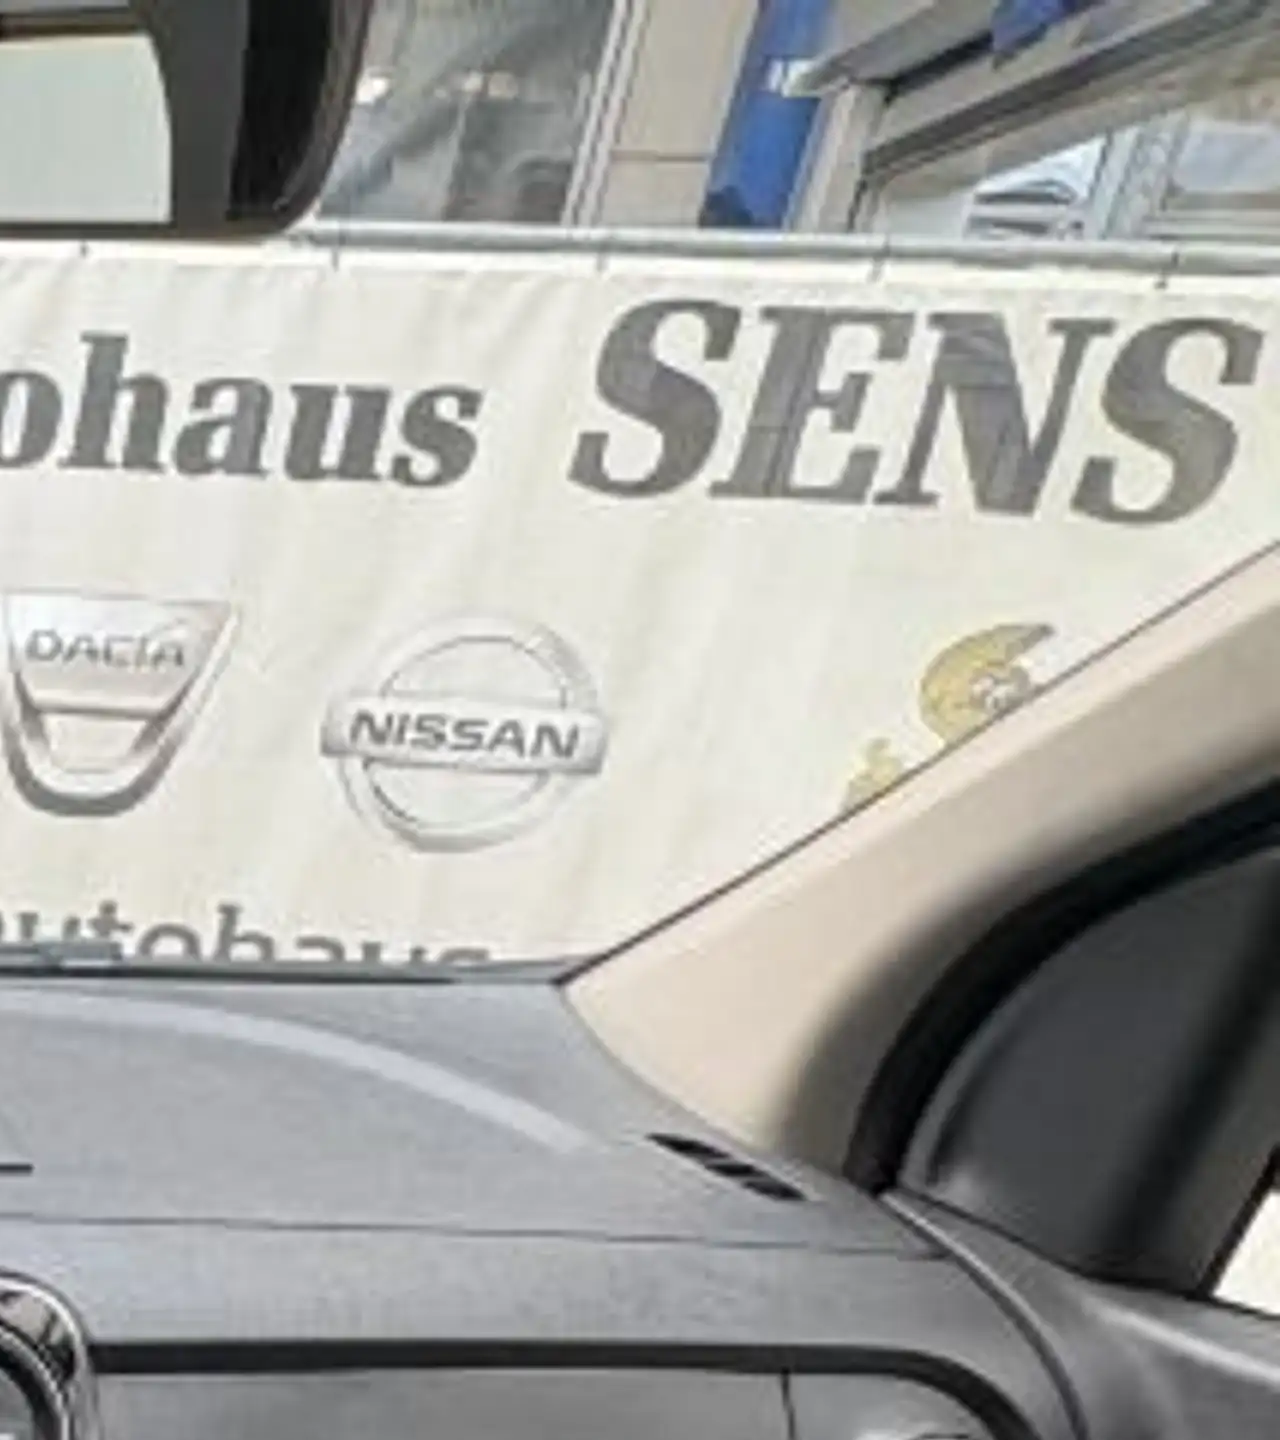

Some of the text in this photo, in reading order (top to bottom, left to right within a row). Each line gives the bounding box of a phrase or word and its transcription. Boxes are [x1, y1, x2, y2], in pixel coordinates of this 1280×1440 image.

[566, 298, 1266, 526] SENS
[24, 627, 188, 672] DACIA
[346, 709, 583, 762] NISSAN
